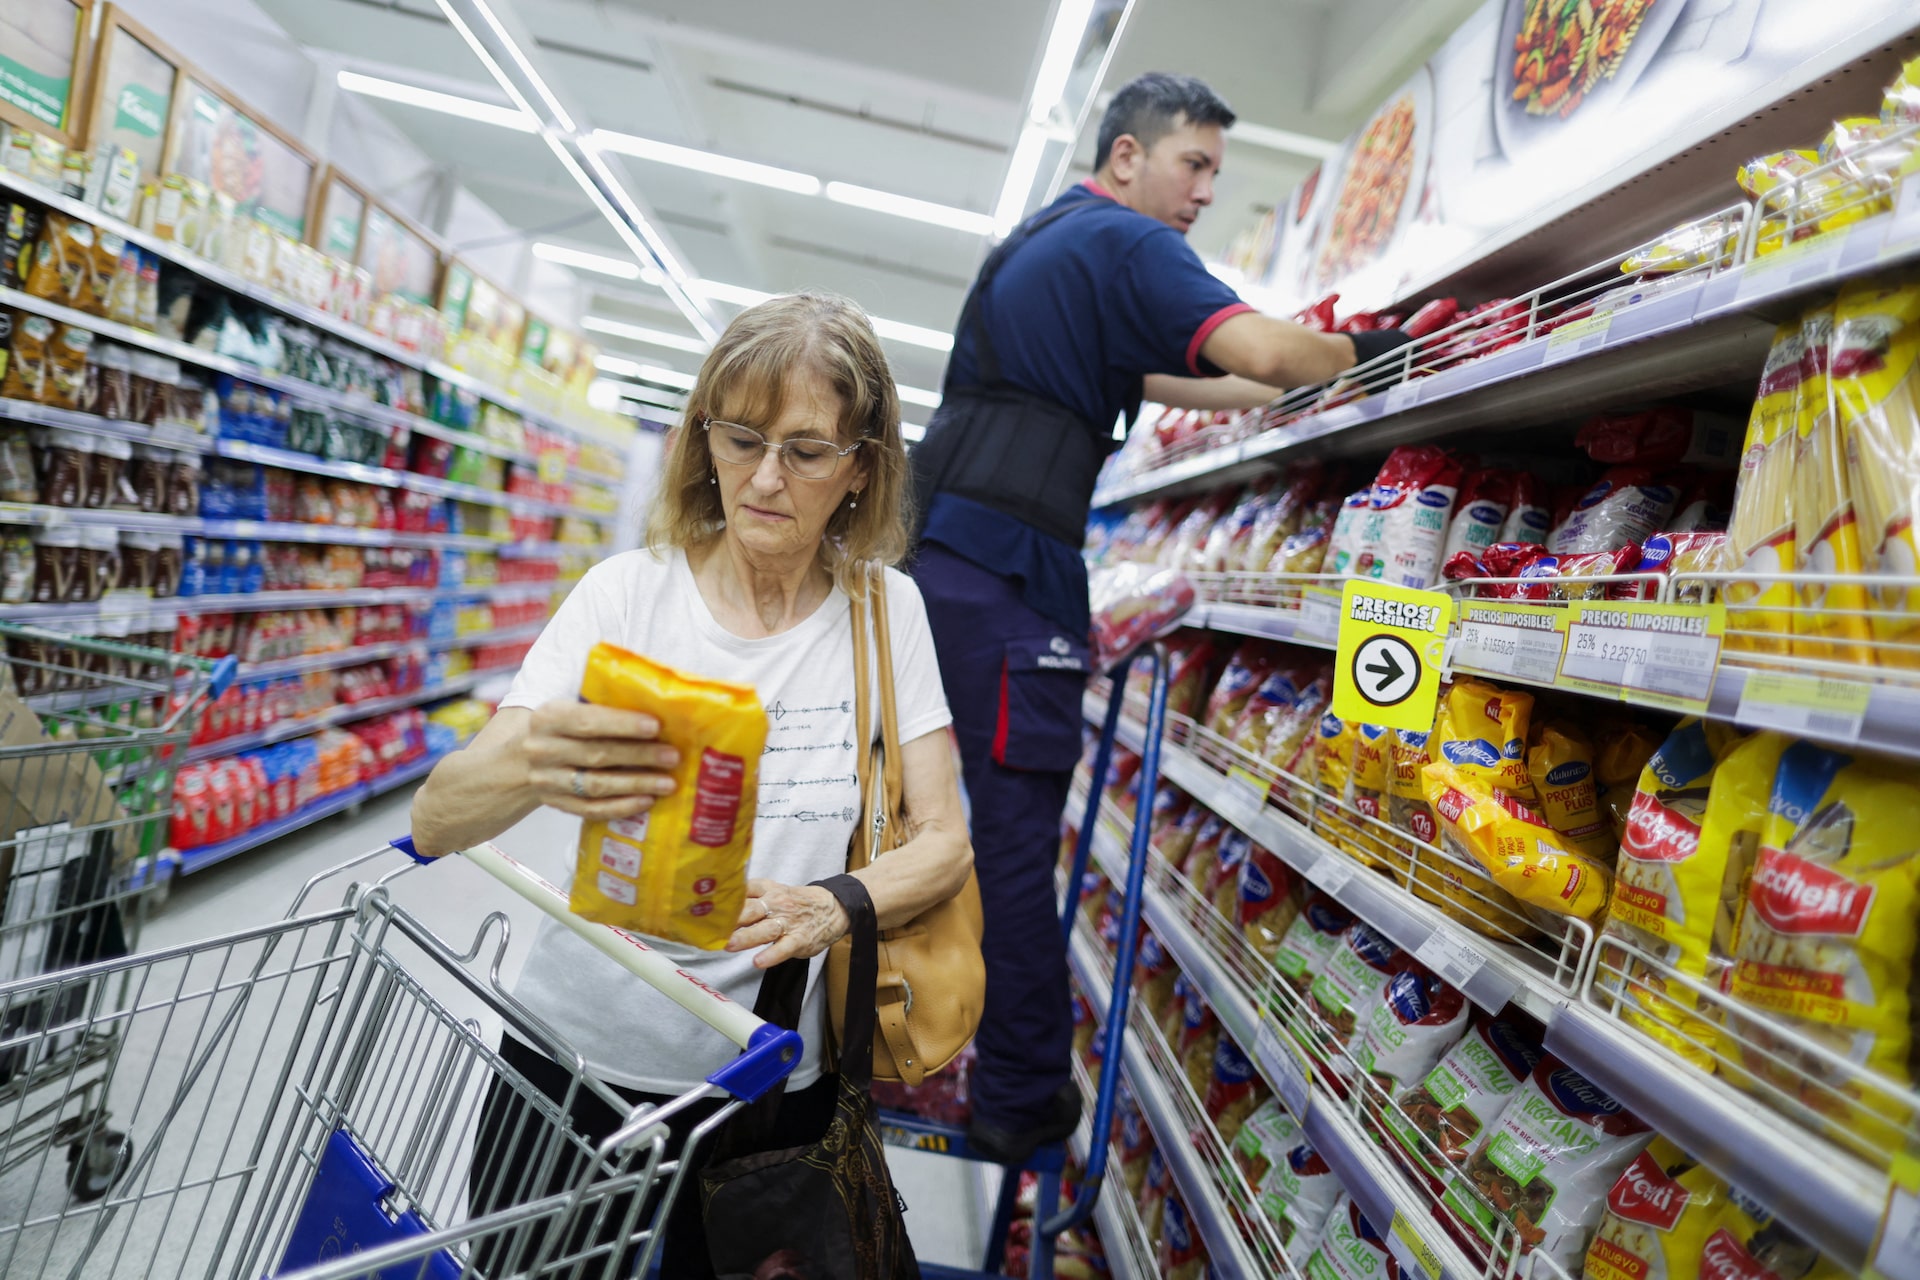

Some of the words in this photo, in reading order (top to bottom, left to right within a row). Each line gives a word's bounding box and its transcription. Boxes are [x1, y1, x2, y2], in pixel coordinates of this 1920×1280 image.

[1469, 609, 1501, 624] PRECIOS
[1580, 610, 1629, 627] PRECIOS
[1630, 613, 1710, 637] IMPOSIBLES!
[1577, 633, 1597, 651] 25%
[1437, 797, 1460, 820] NUEVO
[1564, 796, 1593, 812] PLUS
[1413, 814, 1431, 835] 17g
[1522, 1094, 1600, 1154] VEGETALES
[1600, 1243, 1639, 1273] huevo
